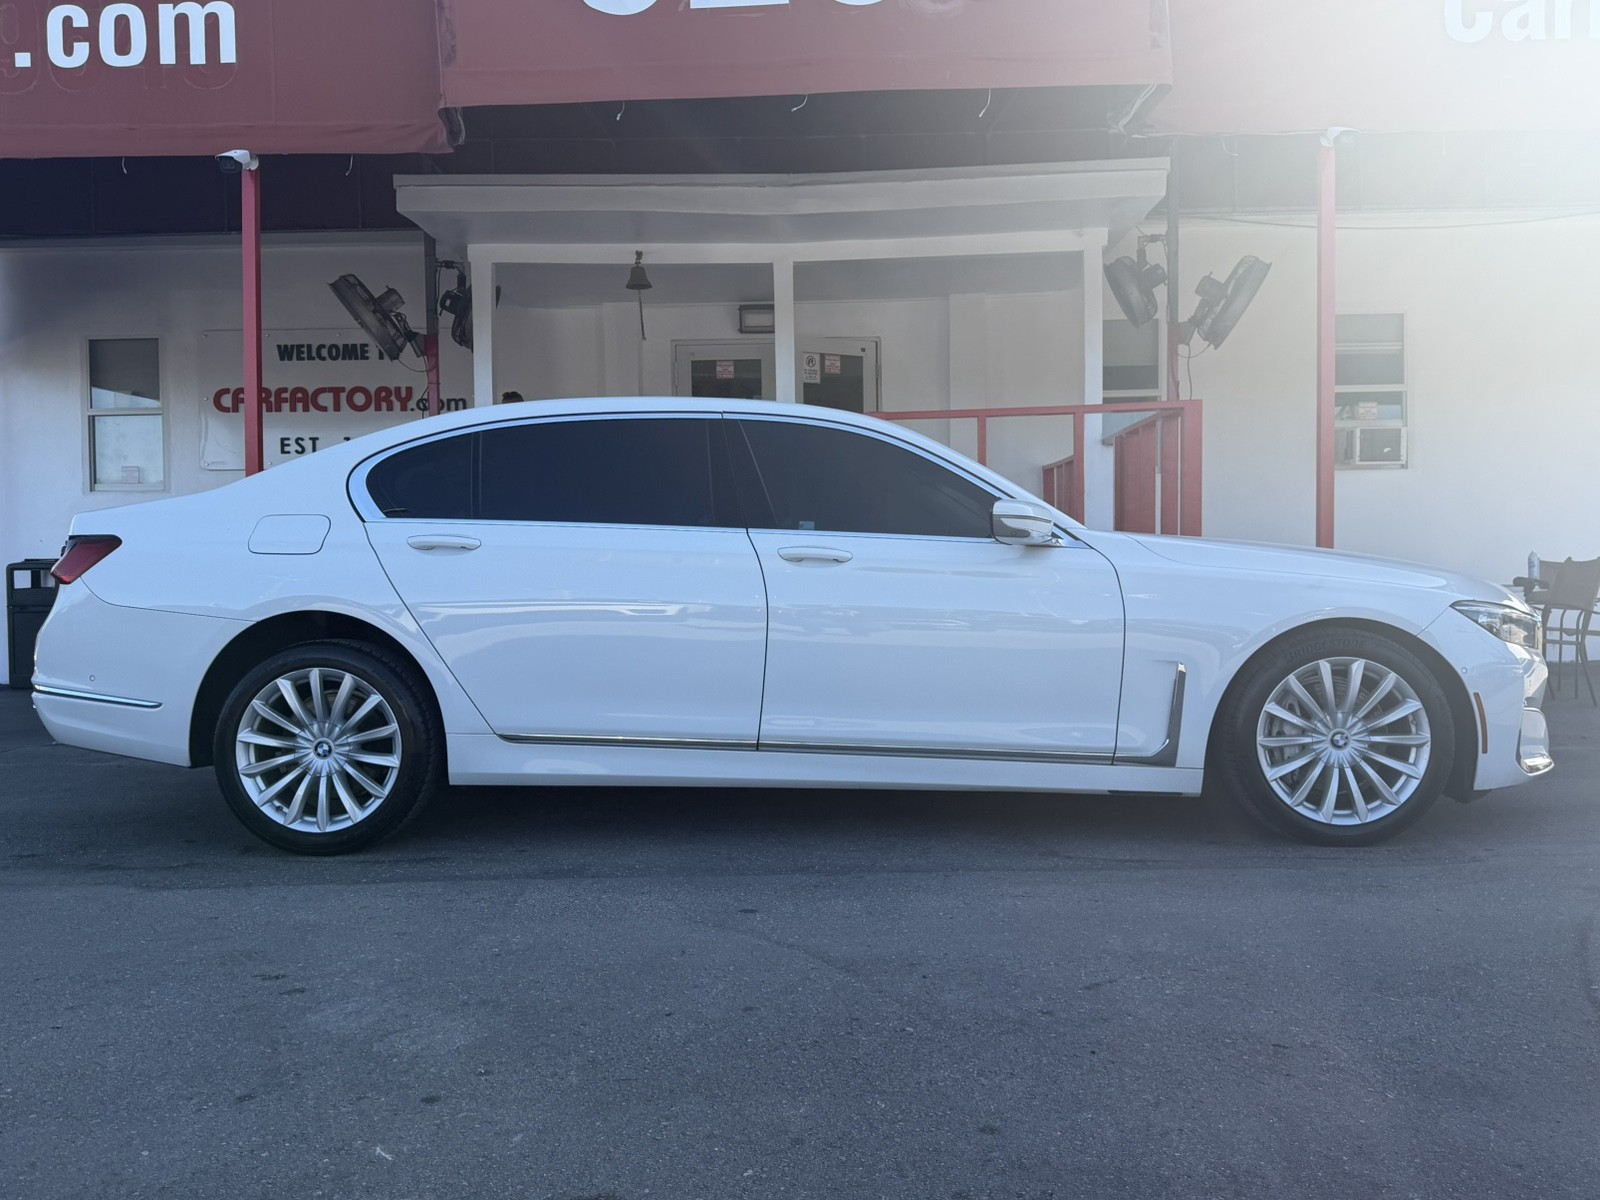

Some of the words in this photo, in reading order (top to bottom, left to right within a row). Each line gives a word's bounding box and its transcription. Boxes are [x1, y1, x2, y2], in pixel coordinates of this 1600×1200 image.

[15, 0, 237, 69] .com
[276, 343, 369, 361] WELCOME
[280, 437, 319, 454] EST
